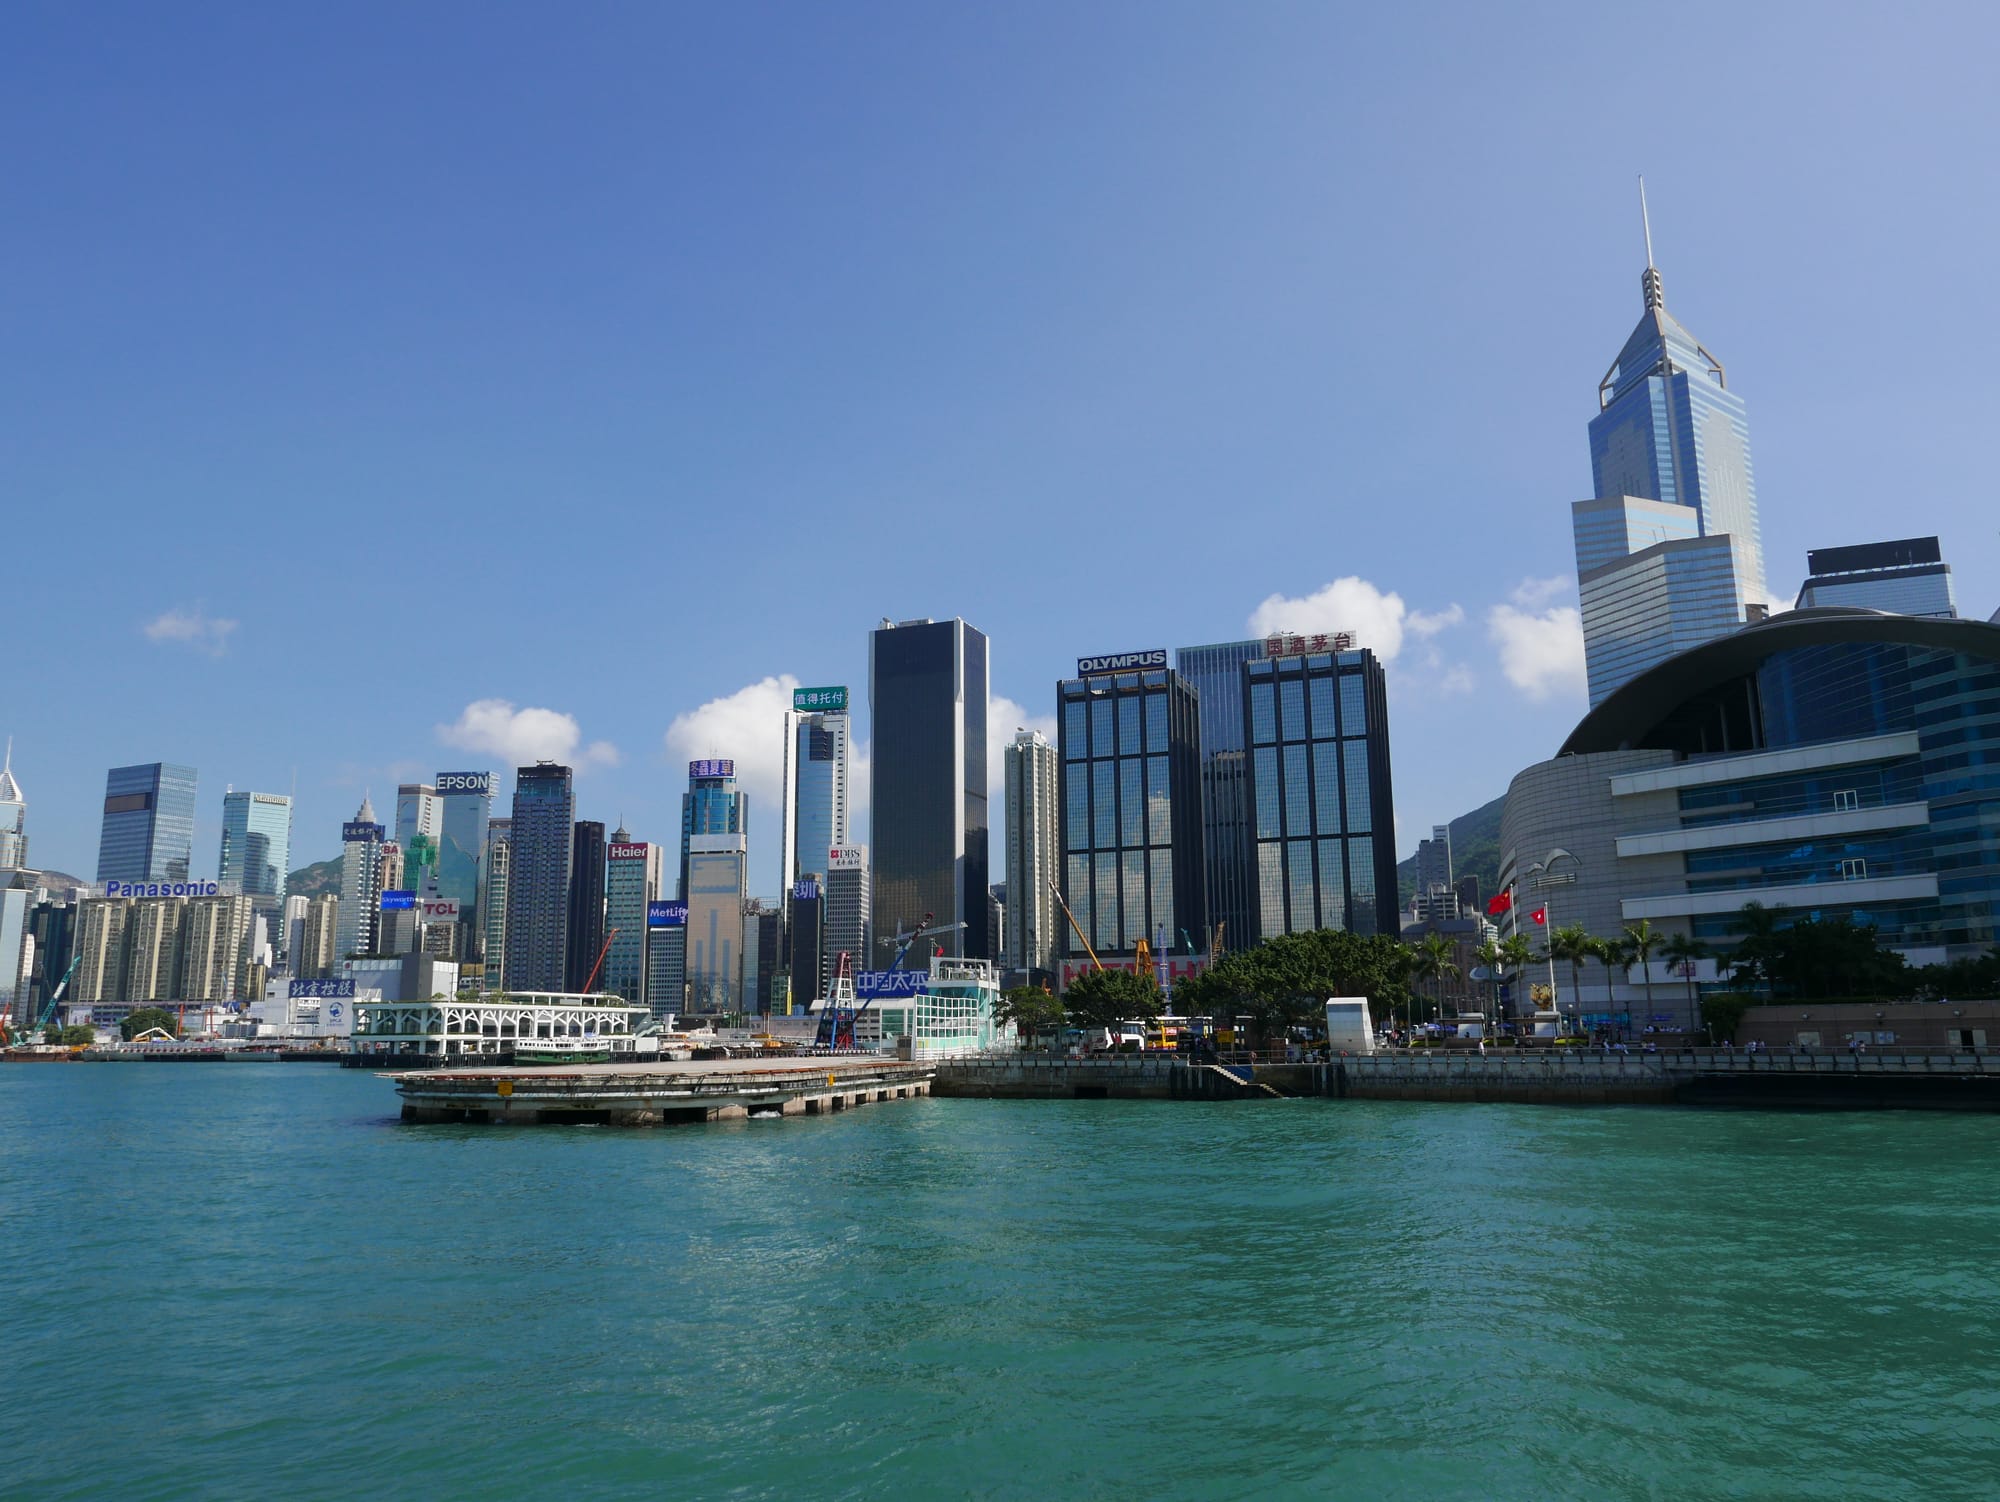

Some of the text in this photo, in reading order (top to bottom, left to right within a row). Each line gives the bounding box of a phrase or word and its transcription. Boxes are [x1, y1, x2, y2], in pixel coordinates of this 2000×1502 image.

[1266, 632, 1351, 656] 国酒茅台
[1078, 652, 1166, 672] OLYMPUS
[795, 691, 843, 705] 值得托付
[437, 775, 488, 790] EPSON
[612, 846, 647, 857] Haier
[840, 849, 860, 858] DBS
[107, 879, 218, 897] Panasonic
[424, 903, 458, 915] TCL
[650, 906, 688, 917] MetLif
[291, 981, 353, 997] 北京控股
[857, 971, 928, 992] 中国太平
